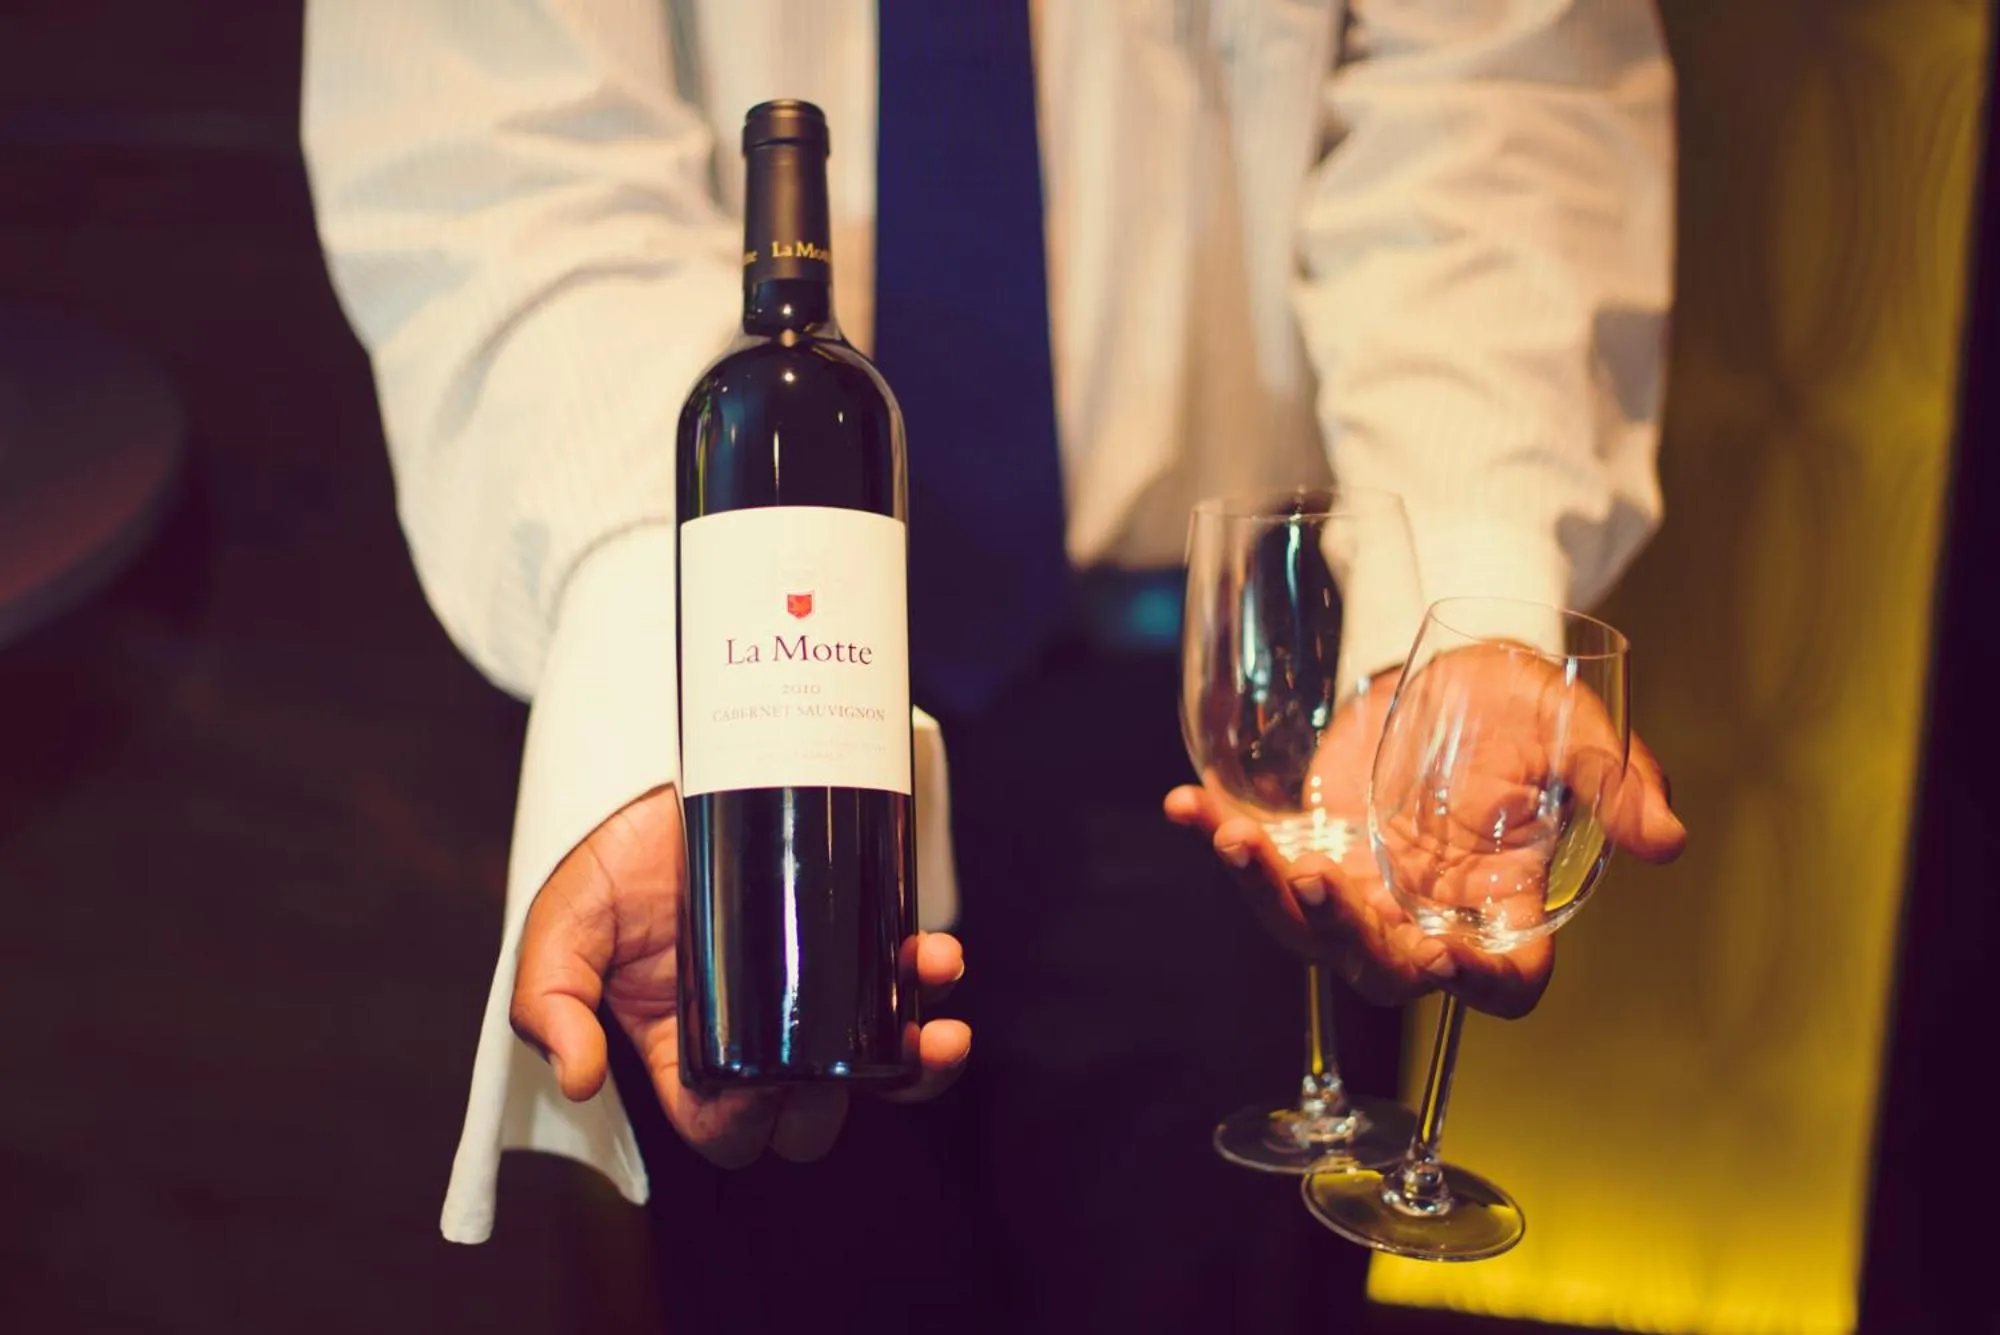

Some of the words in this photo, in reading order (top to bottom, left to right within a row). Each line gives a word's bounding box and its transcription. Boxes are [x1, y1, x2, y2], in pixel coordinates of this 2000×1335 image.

[771, 240, 793, 258] La
[725, 638, 760, 665] La
[772, 634, 873, 665] Motte
[781, 683, 822, 695] 2010
[712, 704, 791, 722] CABERNET
[796, 703, 886, 722] SAUVIGNON
